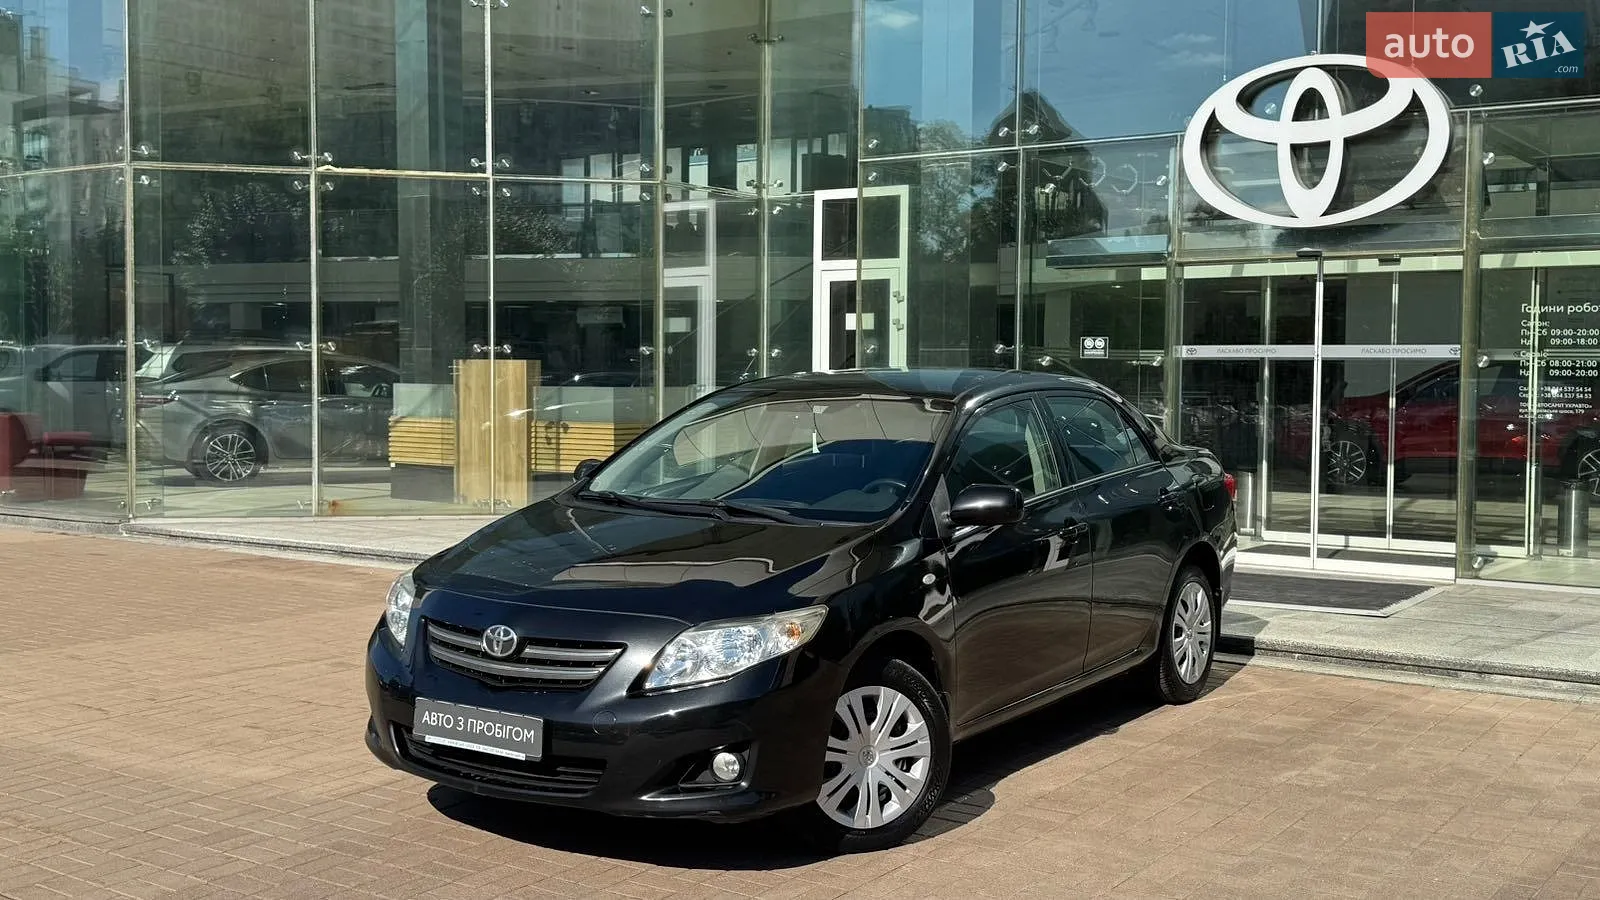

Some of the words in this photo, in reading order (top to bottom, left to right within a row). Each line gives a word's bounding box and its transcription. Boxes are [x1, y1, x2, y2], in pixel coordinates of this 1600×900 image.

[1521, 303, 1564, 314] Години
[1567, 302, 1600, 315] робо
[1520, 319, 1551, 328] Саон:
[1550, 328, 1600, 336] 09:00-20:00
[1550, 338, 1598, 346] 09:00-18:00
[421, 710, 454, 729] АВТО
[467, 718, 535, 744] ПРОБІГОМ
